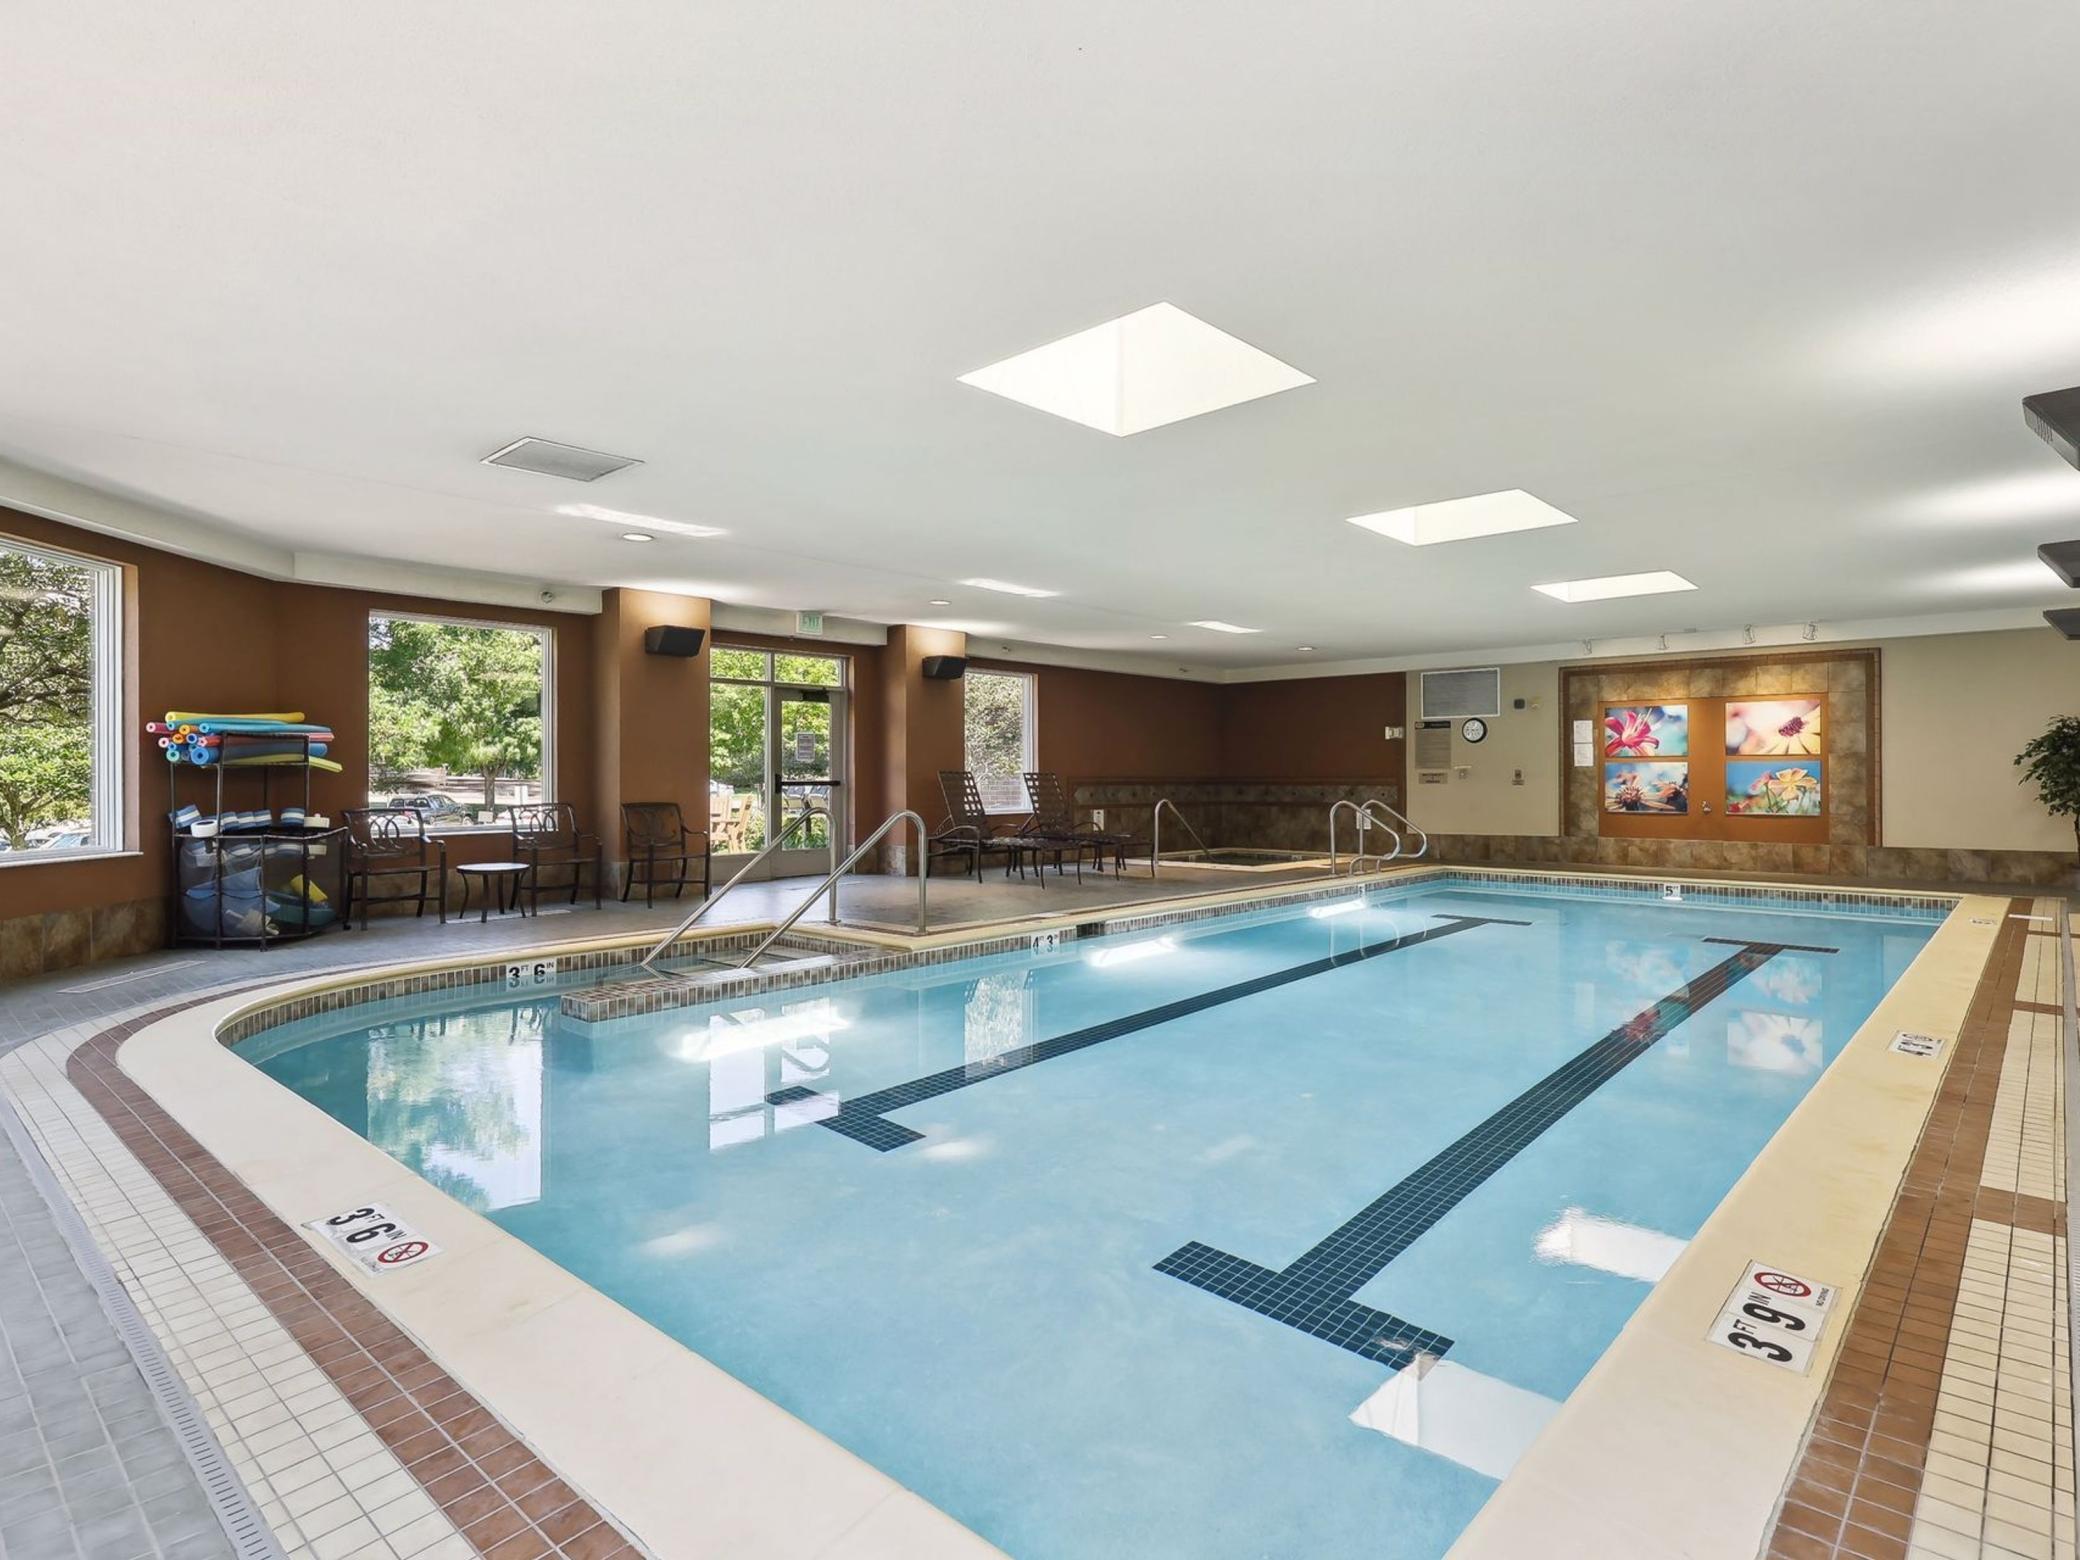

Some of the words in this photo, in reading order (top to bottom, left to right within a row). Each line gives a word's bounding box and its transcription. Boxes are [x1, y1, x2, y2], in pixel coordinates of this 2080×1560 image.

[1665, 885, 1674, 896] 5
[1032, 936, 1039, 948] 4
[533, 963, 546, 982] 6
[326, 1207, 376, 1226] 3
[346, 1222, 397, 1243] 6
[1747, 1291, 1772, 1306] IN
[1742, 1302, 1806, 1331] 9
[1732, 1319, 1758, 1335] FT
[1727, 1332, 1793, 1363] 3
